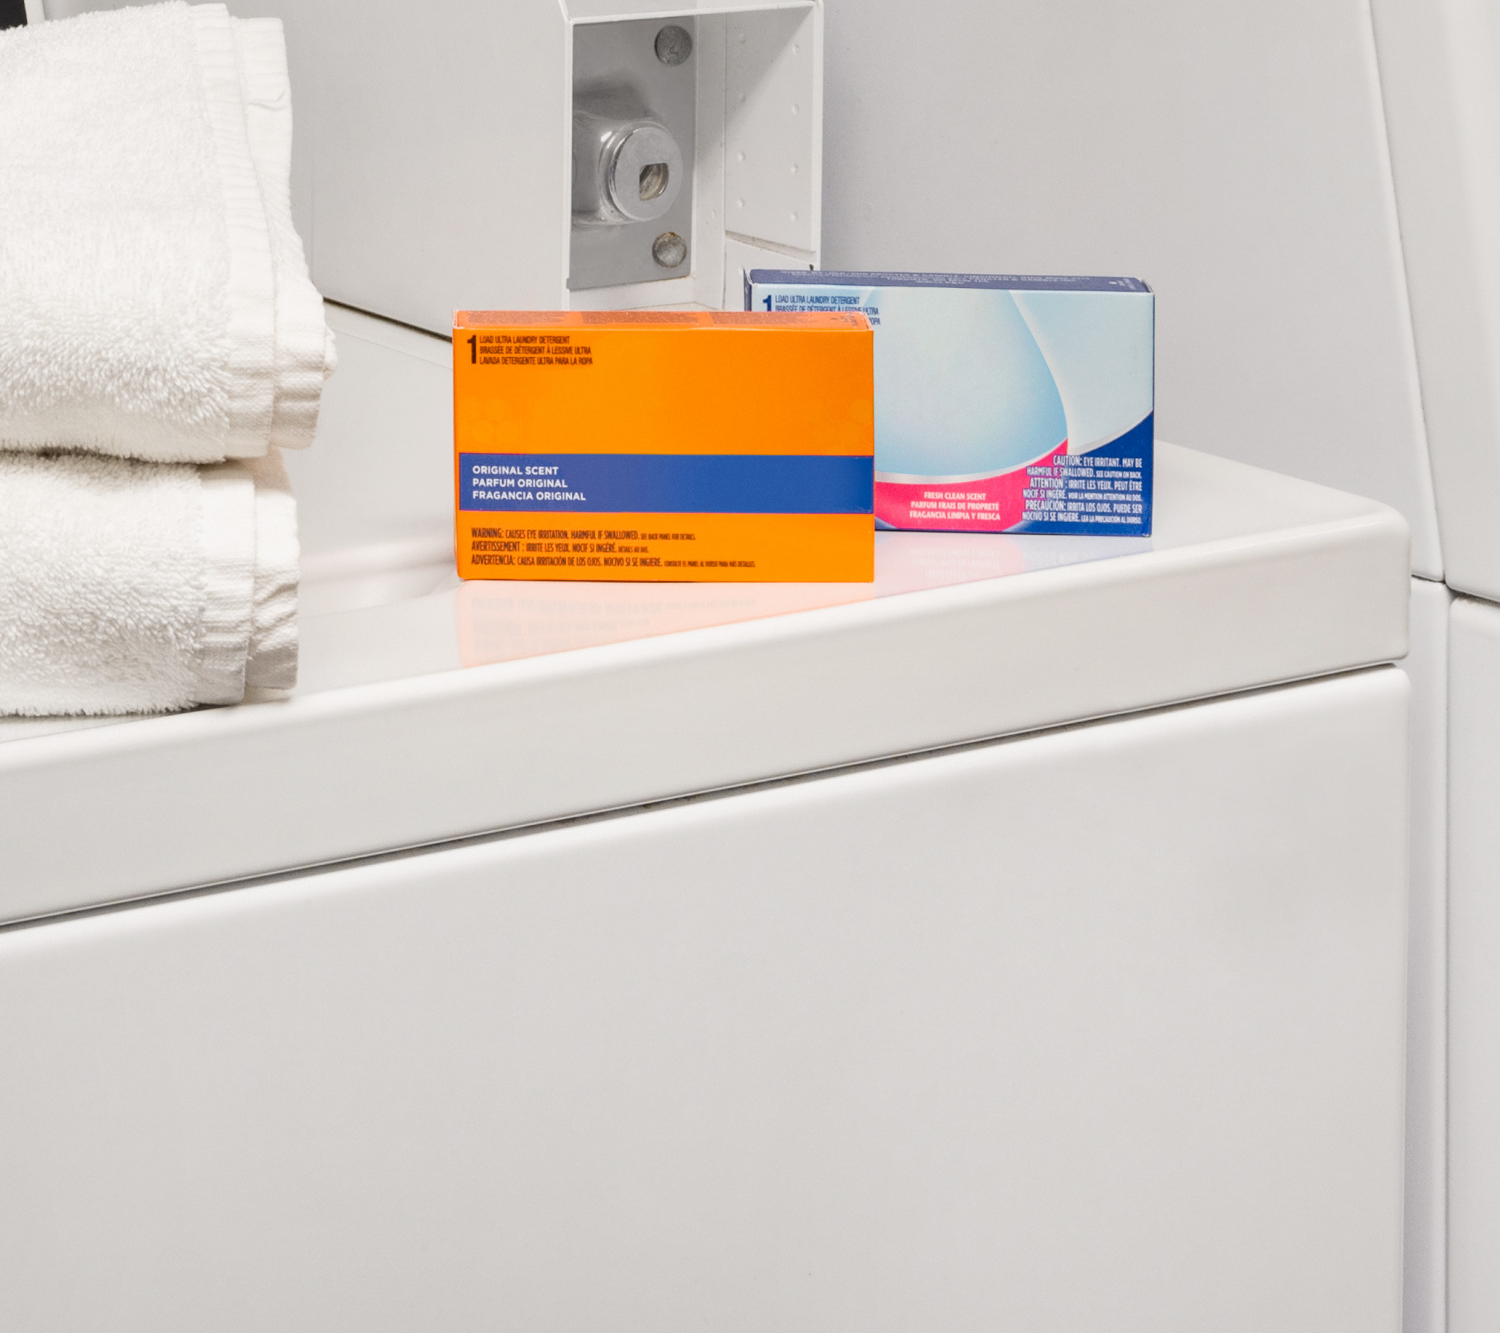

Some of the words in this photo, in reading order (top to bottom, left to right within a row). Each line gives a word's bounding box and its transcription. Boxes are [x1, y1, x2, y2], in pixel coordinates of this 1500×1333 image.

[775, 295, 789, 303] LOAD
[790, 295, 805, 304] ULTRA
[806, 295, 830, 304] LAUNDRY
[831, 296, 860, 305] DETERGENT
[479, 336, 494, 344] LOAD
[495, 336, 511, 344] ULTRA
[513, 336, 538, 344] LAUNDRY
[539, 336, 570, 344] DETERGENT
[467, 335, 476, 364] 1
[505, 346, 513, 354] DE
[551, 346, 573, 355] LESSIVE
[574, 346, 592, 355] ULTRA
[479, 356, 500, 365] LAVADA
[501, 356, 536, 365] DETERGENTE
[537, 356, 554, 365] ULTRA
[555, 357, 569, 365] PARA
[570, 357, 578, 365] LA
[578, 357, 594, 365] ROPA
[1053, 455, 1082, 466] CAUTION:
[1083, 457, 1093, 466] EYE
[1122, 458, 1134, 467] MAY
[1135, 458, 1143, 468] BE
[472, 465, 522, 475] ORIGINAL
[525, 466, 559, 475] SCENT
[1027, 466, 1052, 476] HARMFUL
[472, 478, 515, 487] PARFUM
[517, 479, 568, 488] ORIGINAL
[1030, 477, 1063, 488] ATTENTION
[1087, 480, 1096, 489] LES
[1114, 480, 1128, 490] PEUT
[472, 490, 533, 500] FRAGANCIA
[536, 491, 586, 501] ORIGINAL
[924, 491, 943, 500] FRESH
[944, 492, 965, 500] CLEAN
[966, 492, 986, 501] SCENT
[910, 501, 937, 509] PARFUM
[938, 501, 956, 510] FRAIS
[957, 502, 966, 510] DE
[1085, 502, 1095, 512] LOS
[1113, 503, 1131, 513] PUEDE
[1132, 503, 1143, 514] SER
[909, 510, 946, 519] FRAGANCIA
[947, 511, 970, 520] LIMPIA
[977, 512, 1000, 521] FRESCA
[471, 528, 503, 538] WARNING:
[505, 529, 526, 539] CAUSES
[527, 529, 537, 539] EYE
[471, 541, 520, 552] AVERTISSEMENT
